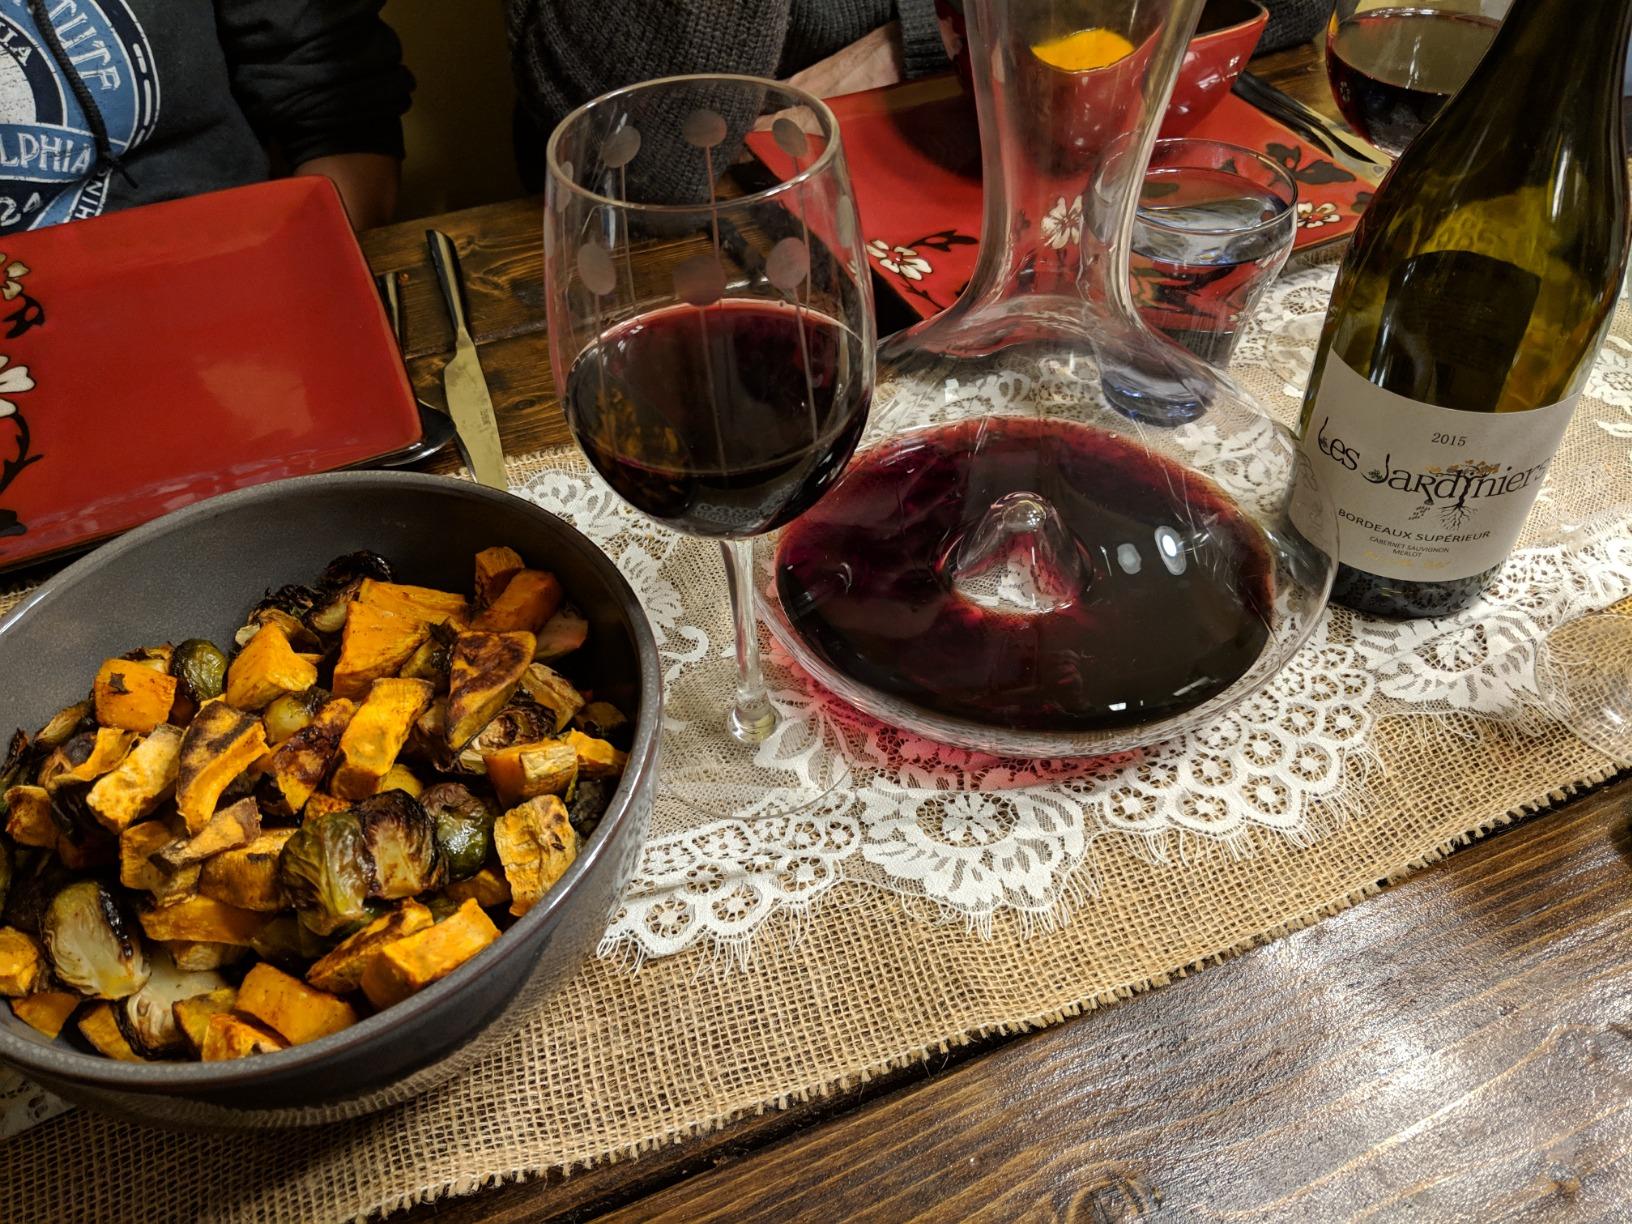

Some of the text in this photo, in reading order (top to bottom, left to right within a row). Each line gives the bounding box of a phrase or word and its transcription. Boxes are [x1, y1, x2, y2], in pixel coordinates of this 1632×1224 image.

[1318, 416, 1360, 471] Les
[1431, 432, 1467, 447] 2015
[1338, 508, 1412, 540] BORDEAUX
[1369, 536, 1449, 553] CABERNET SAUVIGNON
[1392, 548, 1422, 557] MERLOT
